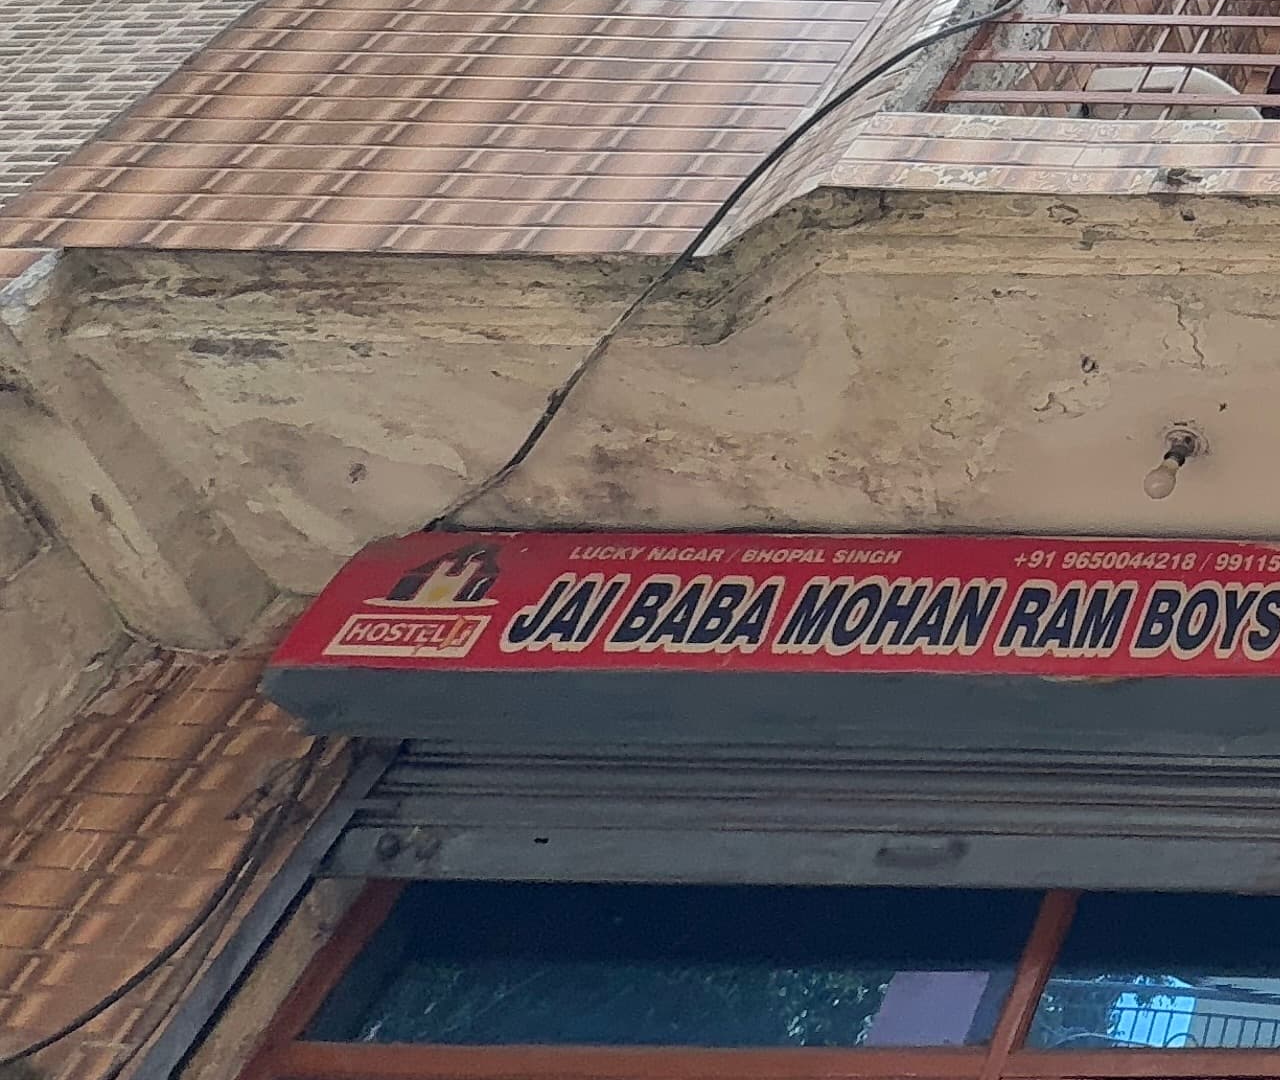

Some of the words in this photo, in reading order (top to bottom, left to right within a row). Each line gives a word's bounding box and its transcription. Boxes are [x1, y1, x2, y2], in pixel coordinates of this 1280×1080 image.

[568, 546, 643, 561] LUCKY
[646, 546, 723, 563] NAGAR
[741, 548, 827, 564] BHOPAL
[832, 549, 903, 565] SINGH
[1014, 550, 1057, 568] +91
[1062, 551, 1198, 570] 9650044218
[501, 573, 631, 652] JAI
[603, 574, 786, 653] BABA
[771, 575, 1008, 656] MOHAN
[993, 578, 1140, 658] RAM
